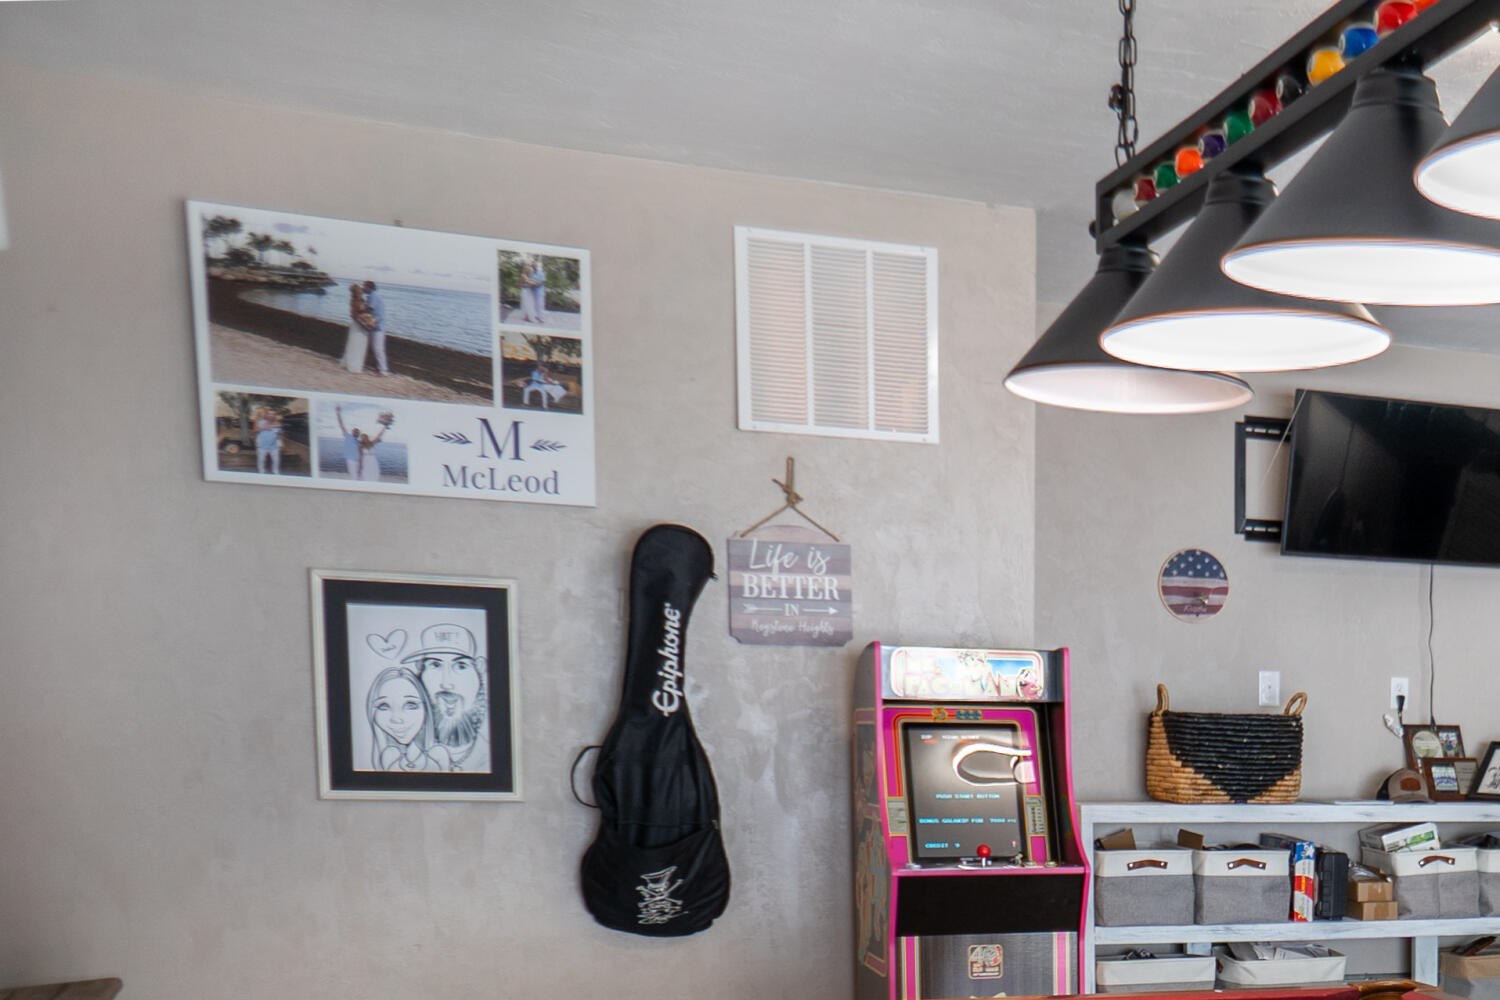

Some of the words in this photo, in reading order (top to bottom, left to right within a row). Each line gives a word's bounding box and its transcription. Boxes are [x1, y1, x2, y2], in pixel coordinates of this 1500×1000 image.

[475, 417, 526, 461] M
[442, 463, 560, 495] McLeod
[749, 537, 799, 575] Life
[807, 546, 831, 576] is
[742, 572, 840, 600] BETTER
[784, 603, 800, 616] IN
[797, 619, 834, 638] Heights
[651, 606, 684, 717] Epiphone
